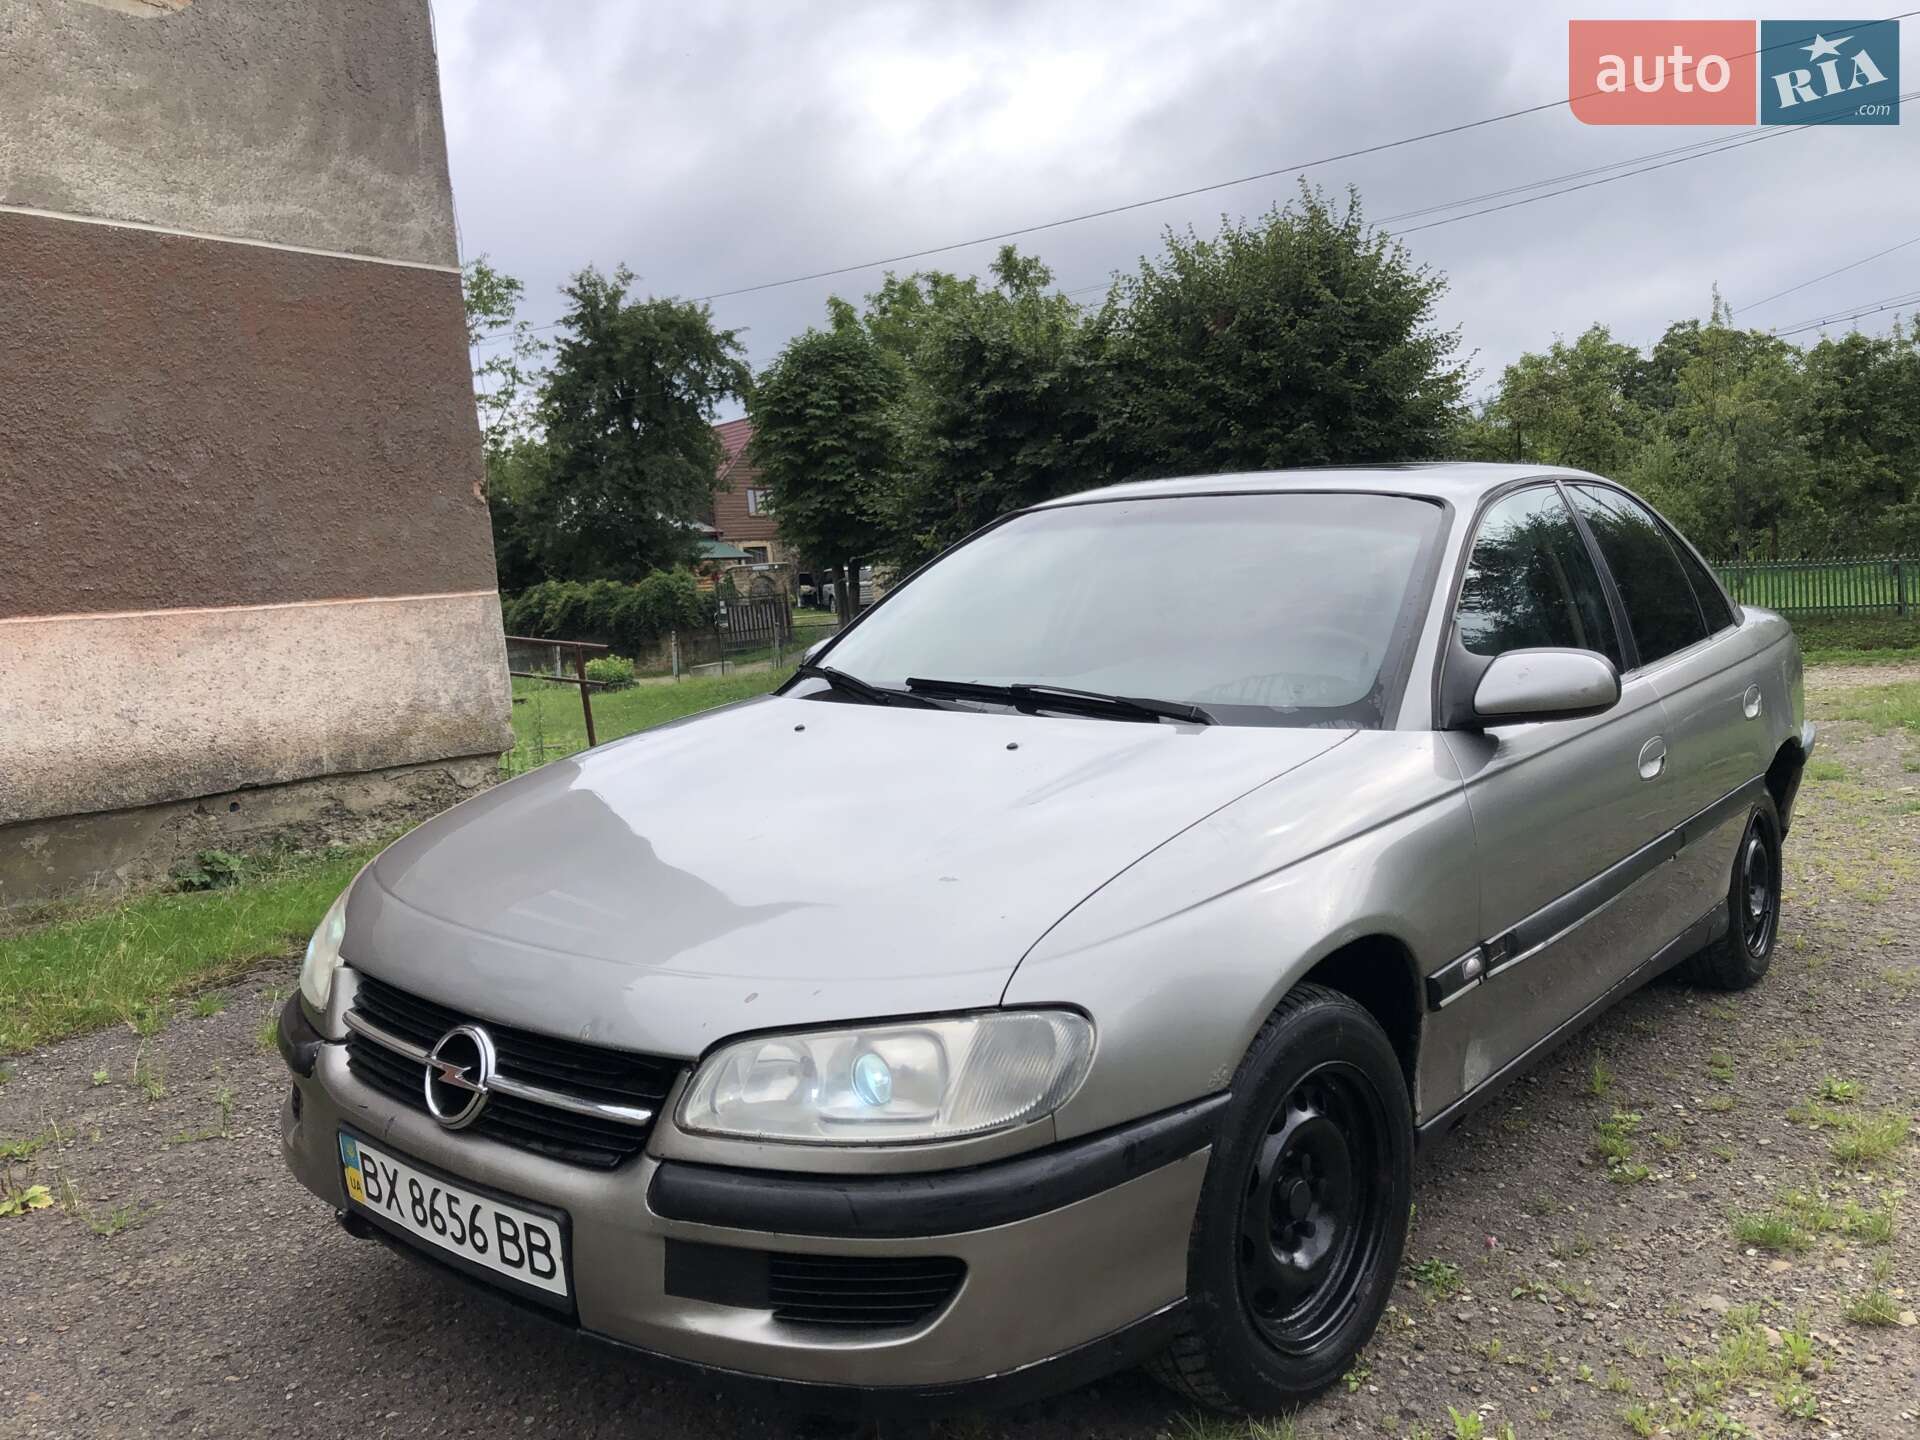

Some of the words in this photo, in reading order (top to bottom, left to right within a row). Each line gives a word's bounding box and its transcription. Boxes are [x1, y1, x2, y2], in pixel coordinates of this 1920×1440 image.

[349, 1177, 363, 1195] UA
[359, 1151, 405, 1218] BX
[408, 1178, 489, 1254] 8656
[494, 1211, 557, 1280] BB
